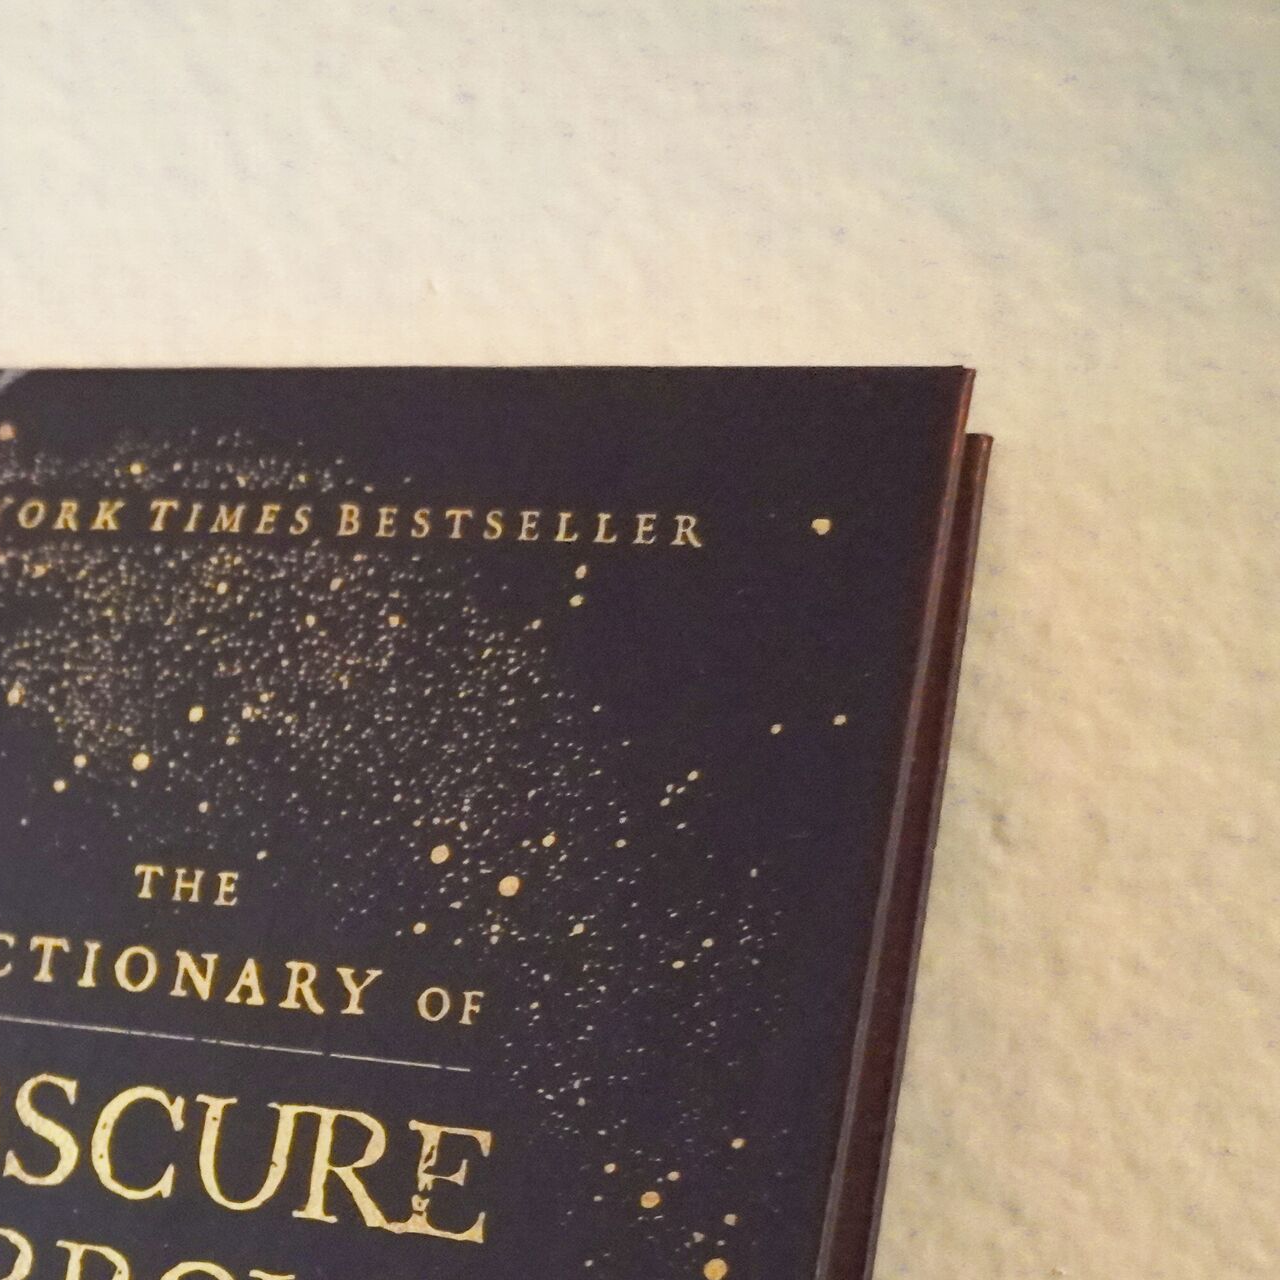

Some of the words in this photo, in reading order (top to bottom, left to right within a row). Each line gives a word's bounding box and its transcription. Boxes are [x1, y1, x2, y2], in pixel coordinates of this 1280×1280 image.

[149, 499, 313, 536] TIMES
[336, 503, 704, 549] BESTSELLER
[134, 863, 239, 907] THE
[417, 986, 485, 1026] OF
